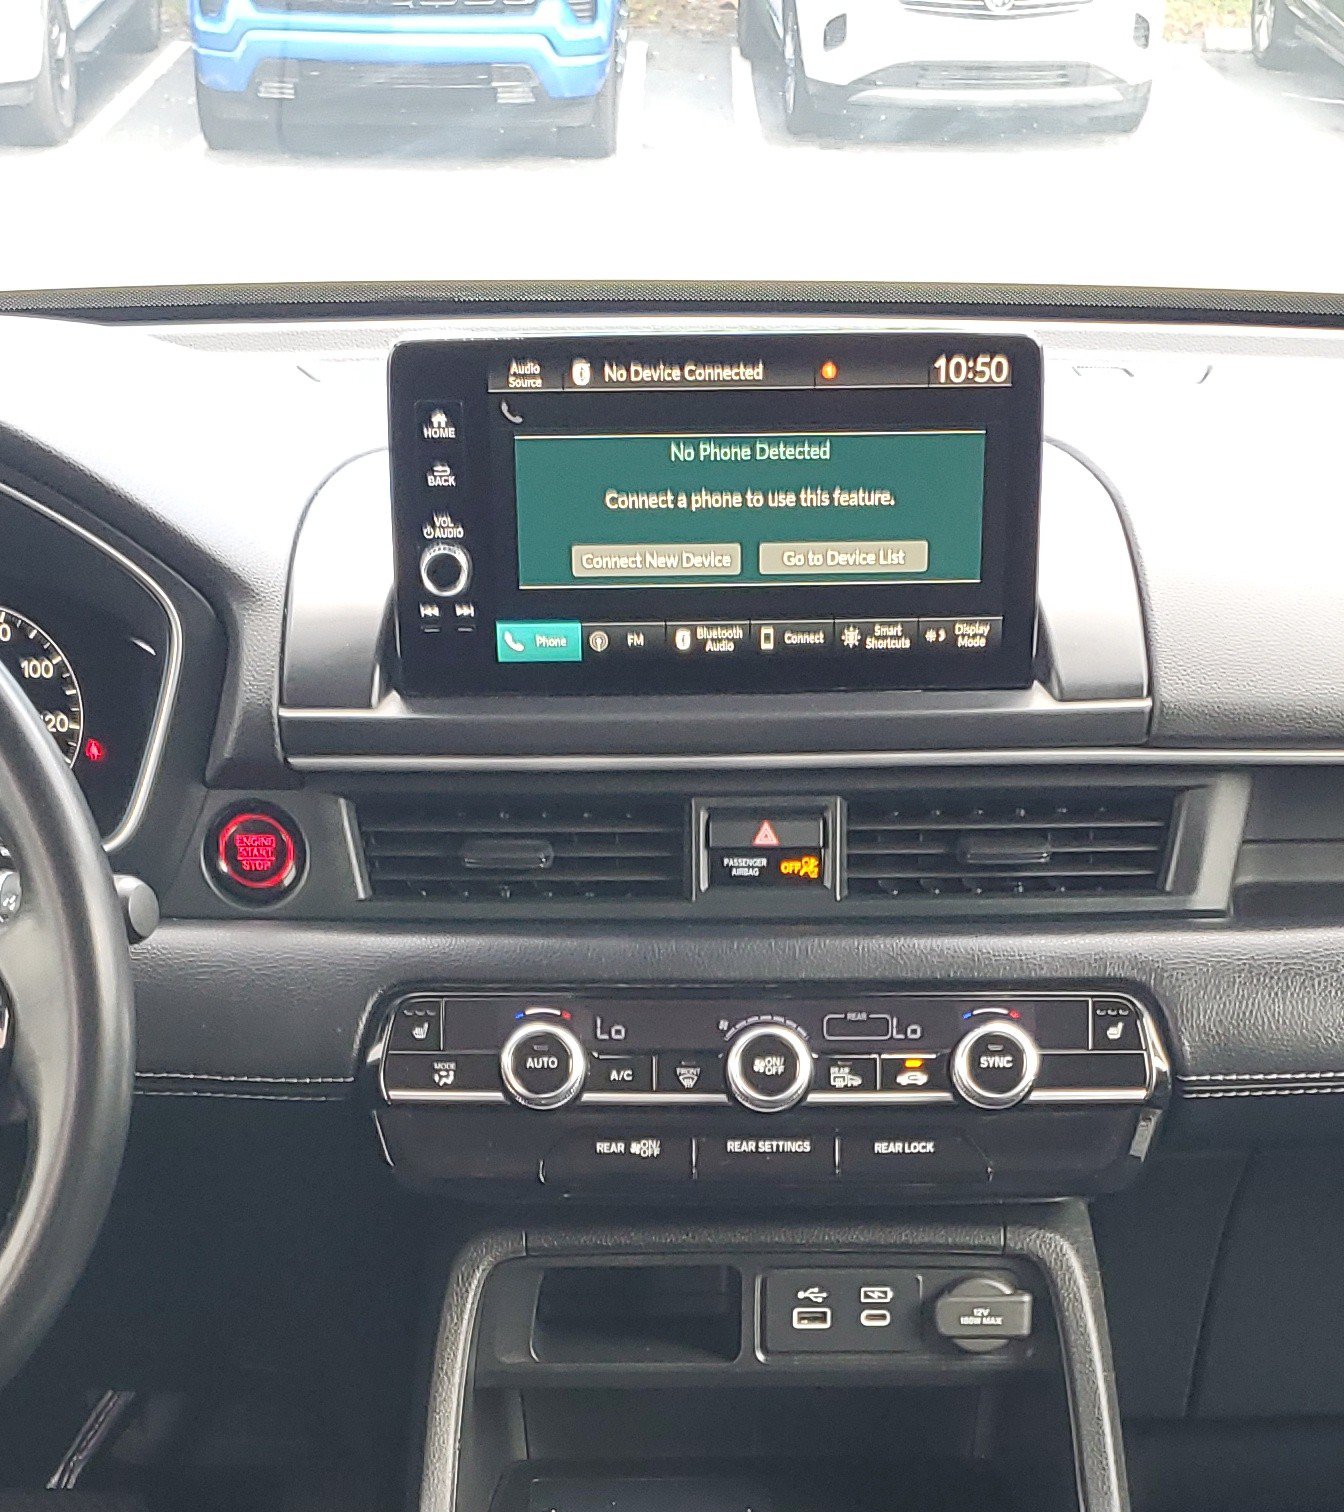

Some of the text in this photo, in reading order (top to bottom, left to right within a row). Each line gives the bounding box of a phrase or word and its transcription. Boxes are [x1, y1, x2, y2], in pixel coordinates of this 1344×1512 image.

[510, 361, 540, 375] Audio
[604, 360, 764, 381] No Device Connected
[934, 355, 1009, 383] 10:50
[509, 376, 542, 388] Source
[423, 427, 456, 438] HOME
[670, 440, 831, 461] No Phone Detected
[427, 475, 456, 486] BACK
[605, 488, 895, 511] Connect a phone to use this feature.
[433, 516, 454, 526] VOL
[435, 527, 464, 538] AUDIO
[582, 552, 731, 569] Connect New Device
[783, 549, 905, 567] Go to Device List
[696, 626, 743, 639] Bluetooth
[874, 624, 902, 636] Smart
[955, 622, 990, 636] Display
[535, 634, 567, 647] Phone
[627, 632, 645, 646] FM
[784, 631, 825, 644] Connect
[866, 636, 910, 650] Shortcuts
[957, 635, 986, 648] Mode
[705, 639, 734, 651] Audio
[21, 661, 54, 679] 100
[242, 860, 271, 871] STOP
[723, 857, 767, 867] PASSENGER
[731, 867, 759, 877] AIRBAG
[846, 1012, 867, 1021] REAR
[433, 1062, 456, 1070] MODE
[525, 1057, 558, 1069] AUTO
[979, 1056, 1013, 1068] SYNC
[610, 1069, 633, 1082] A/C
[675, 1067, 701, 1076] FRONT
[765, 1066, 785, 1076] OFF
[595, 1142, 625, 1154] REAR
[640, 1148, 660, 1158] OFF
[726, 1141, 811, 1153] REAR SETTINGS
[874, 1142, 934, 1154] REAR LOCK
